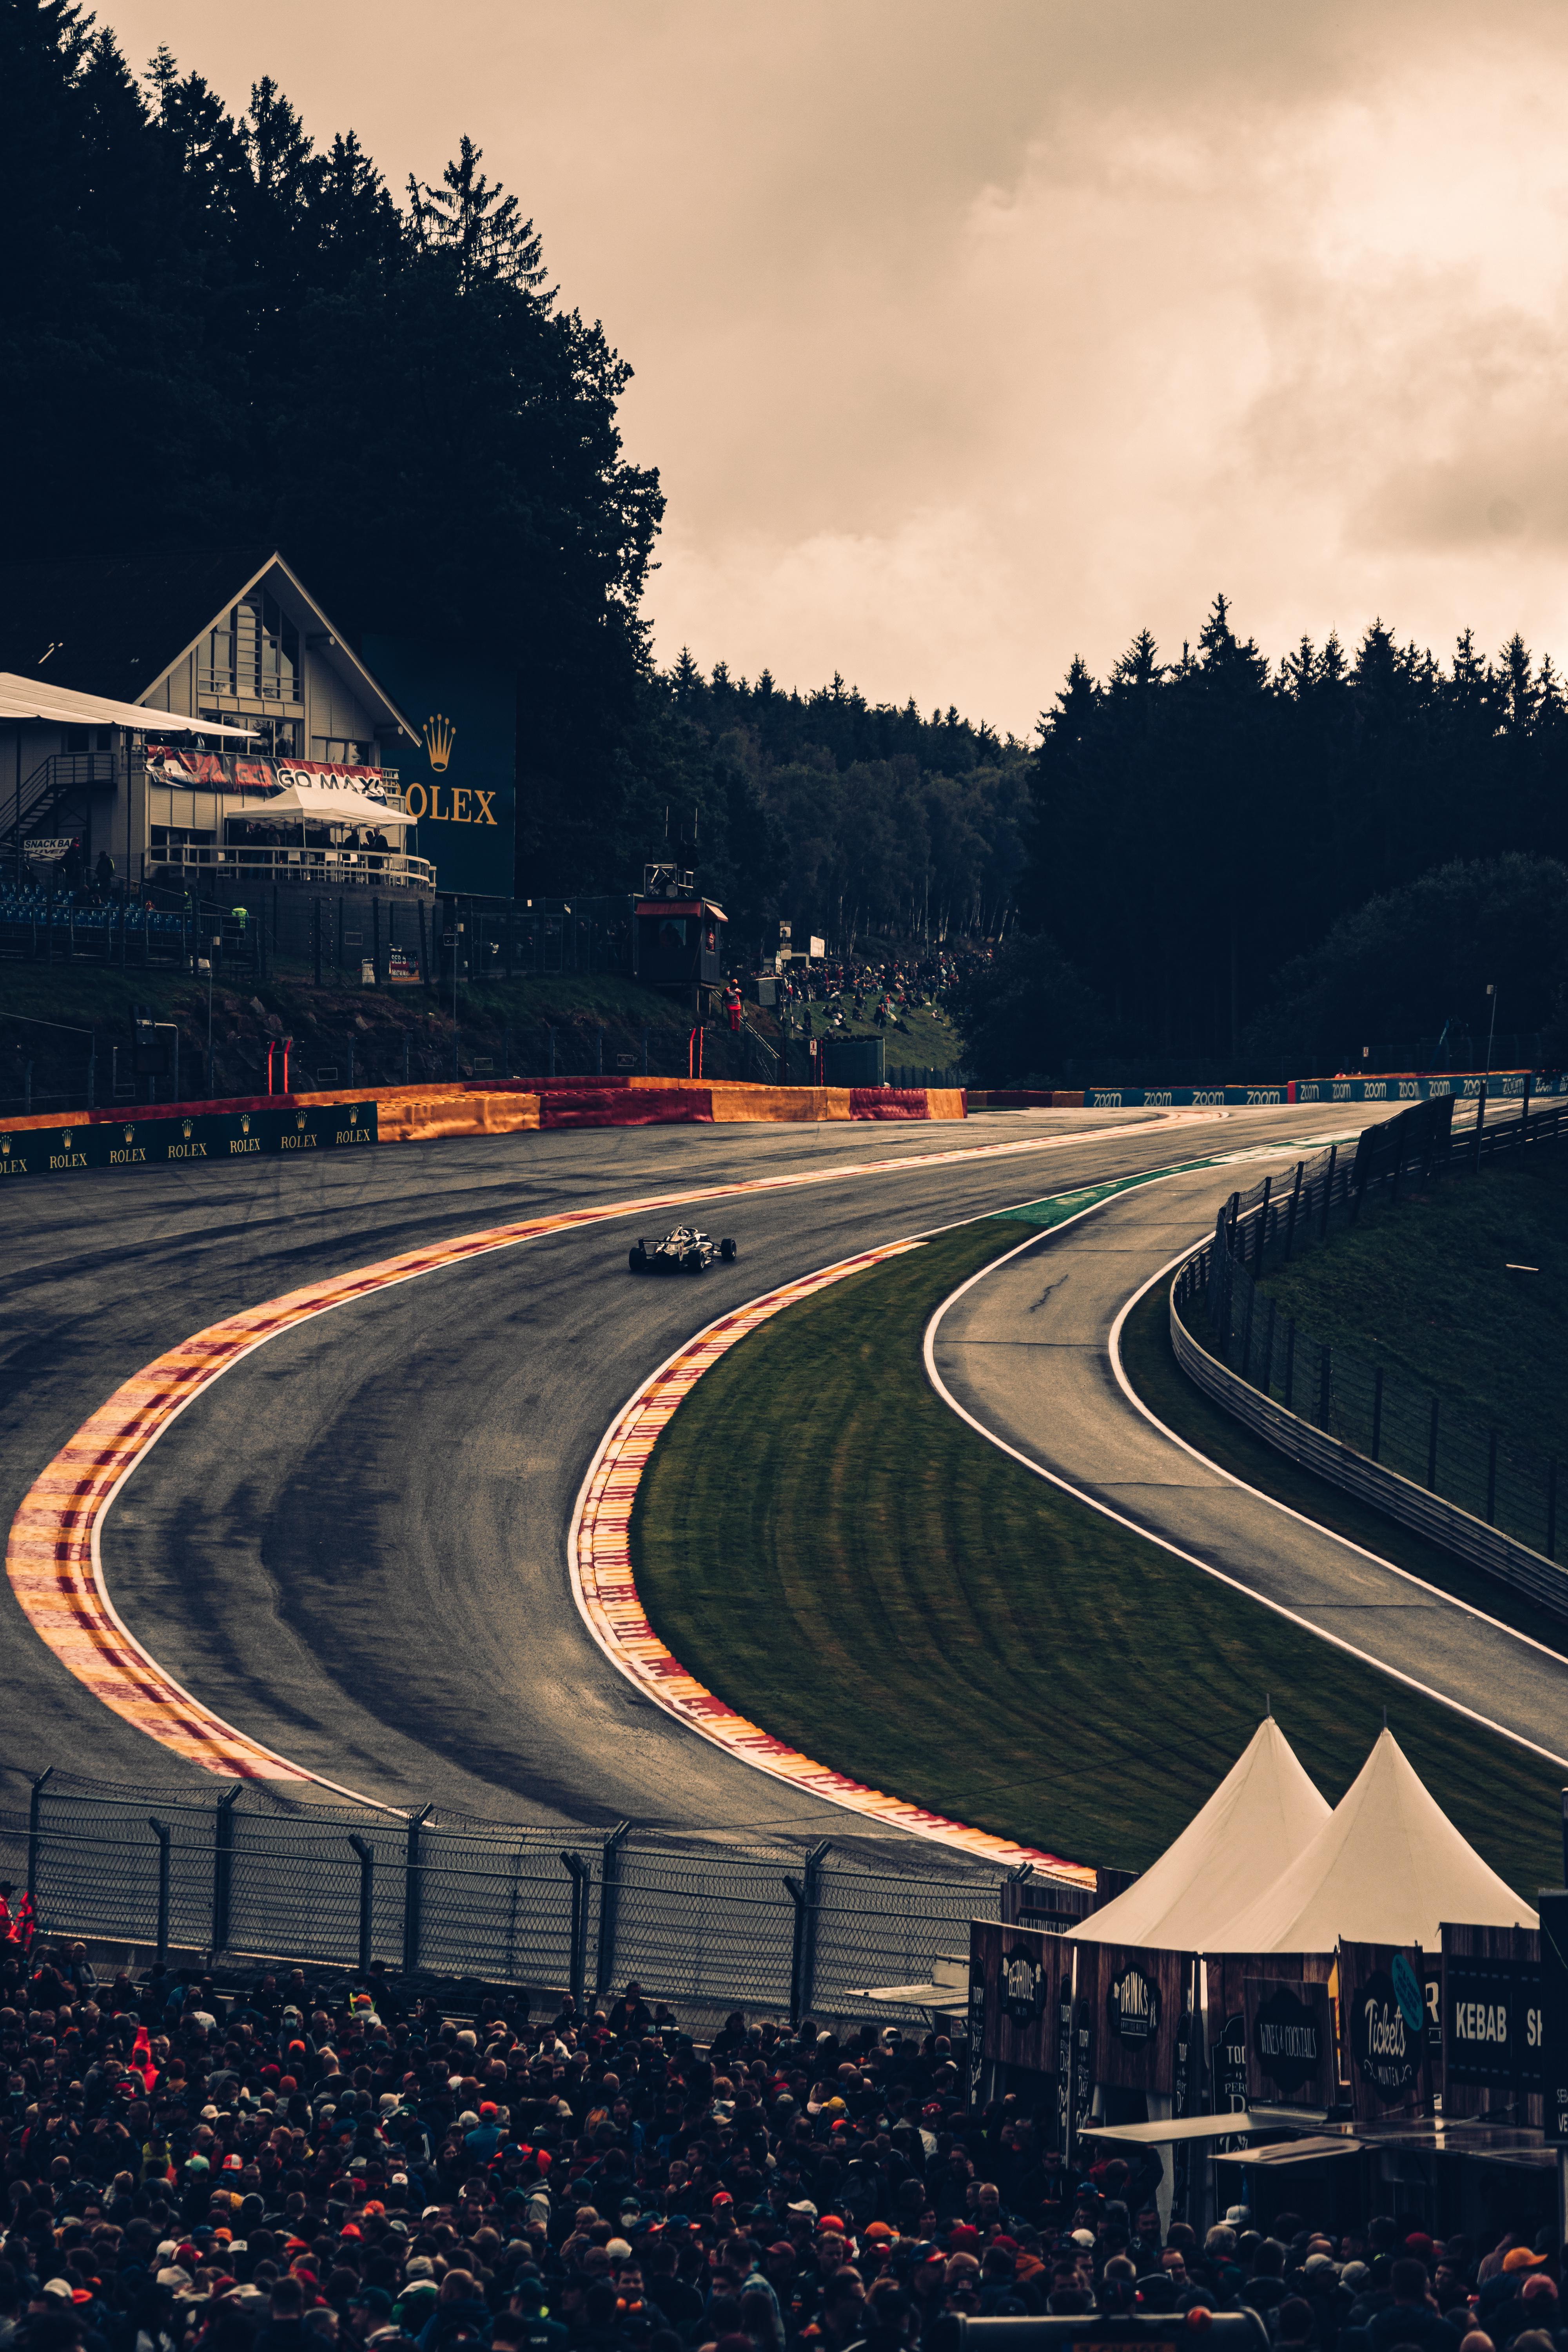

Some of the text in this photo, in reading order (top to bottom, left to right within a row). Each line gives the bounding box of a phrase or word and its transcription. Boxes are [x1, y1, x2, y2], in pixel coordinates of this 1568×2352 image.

[278, 769, 312, 788] GO
[405, 782, 498, 825] OLEX
[25, 840, 56, 848] SNACK
[1301, 1084, 1319, 1100] zoom
[1333, 1083, 1351, 1099] zoom
[1364, 1082, 1387, 1098] zoom
[1429, 1080, 1450, 1097] zoom
[1144, 1092, 1172, 1107] zoom
[1192, 1091, 1224, 1105] zoom
[281, 1134, 317, 1149] ROLEX
[336, 1129, 370, 1143] ROLEX
[168, 1143, 207, 1158] ROLEX
[230, 1138, 260, 1153] ROLEX
[50, 1153, 87, 1169] ROLEX
[110, 1148, 146, 1163] ROLEX
[0, 1159, 27, 1174] LEX
[1009, 1959, 1034, 2001] BEERHOUSE
[1121, 1971, 1148, 2016] DRINKS
[1365, 1998, 1406, 2057] Tickets
[1456, 2002, 1507, 2042] KEBAB
[972, 2031, 981, 2052] DAY
[1260, 2024, 1316, 2059] WINES & COCKTAILS
[1378, 2065, 1399, 2087] MUNTEN
[1078, 2075, 1088, 2097] DAY
[1225, 2082, 1247, 2094] PER
